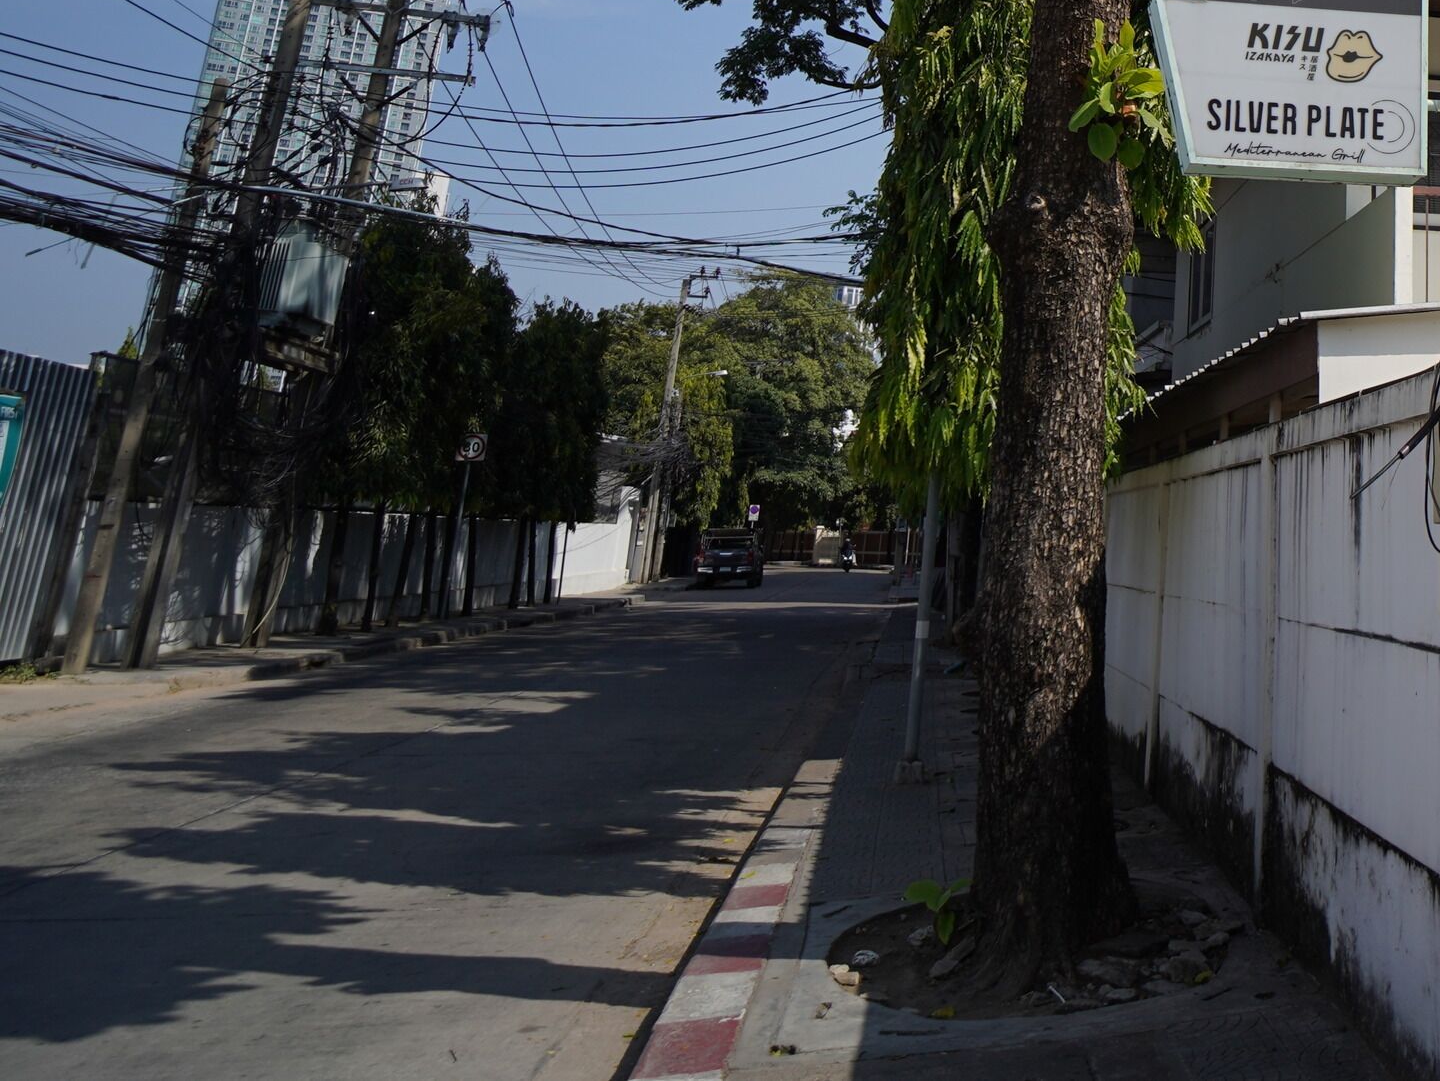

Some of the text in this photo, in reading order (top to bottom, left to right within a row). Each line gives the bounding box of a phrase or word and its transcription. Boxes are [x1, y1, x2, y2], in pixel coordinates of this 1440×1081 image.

[1247, 22, 1325, 53] KISU
[1245, 51, 1295, 64] IZAKAYA
[1206, 98, 1385, 141] SILVER PLATE
[1224, 141, 1365, 163] Mediterranean Grill
